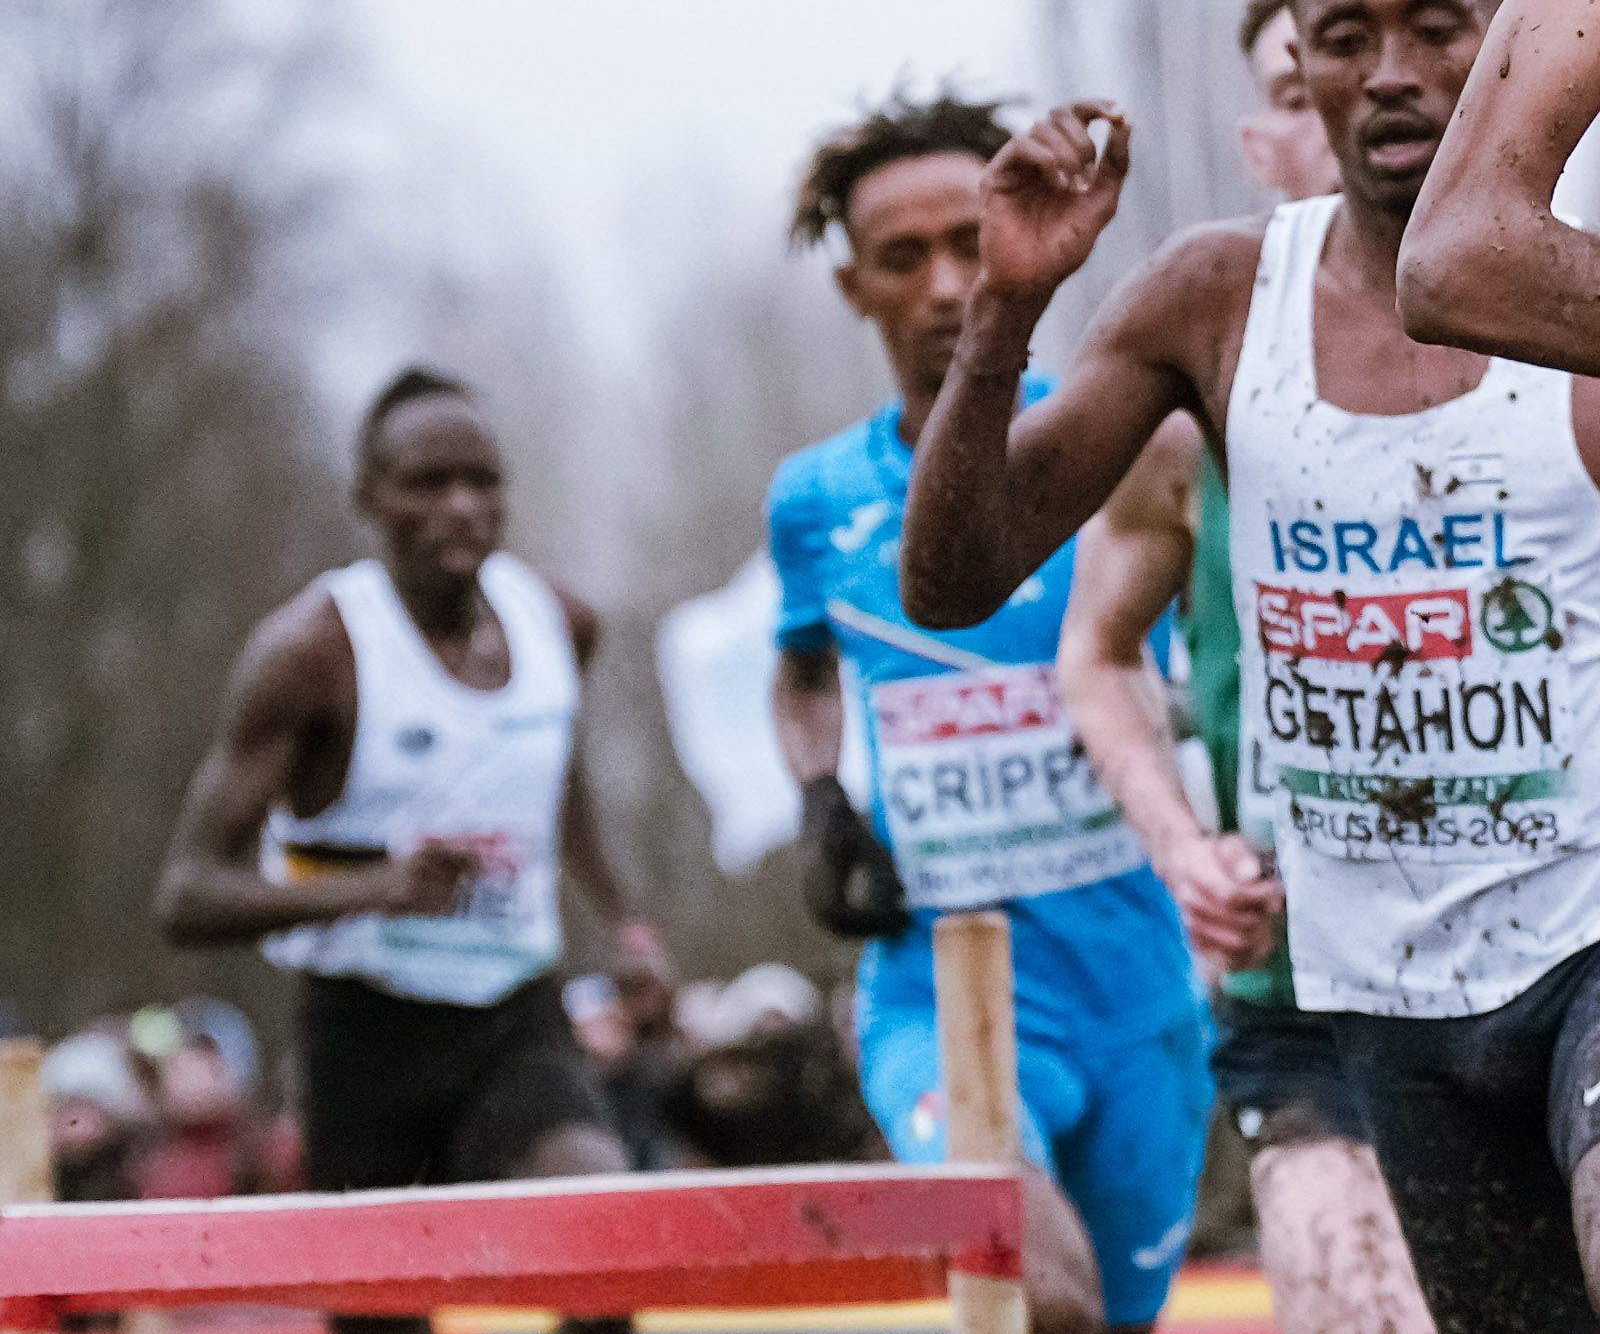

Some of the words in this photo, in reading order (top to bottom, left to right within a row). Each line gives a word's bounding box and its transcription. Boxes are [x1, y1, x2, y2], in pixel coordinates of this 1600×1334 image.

[1268, 512, 1527, 575] ISRAEL
[1258, 592, 1468, 655] SPAR
[1264, 675, 1556, 755] GETAHON
